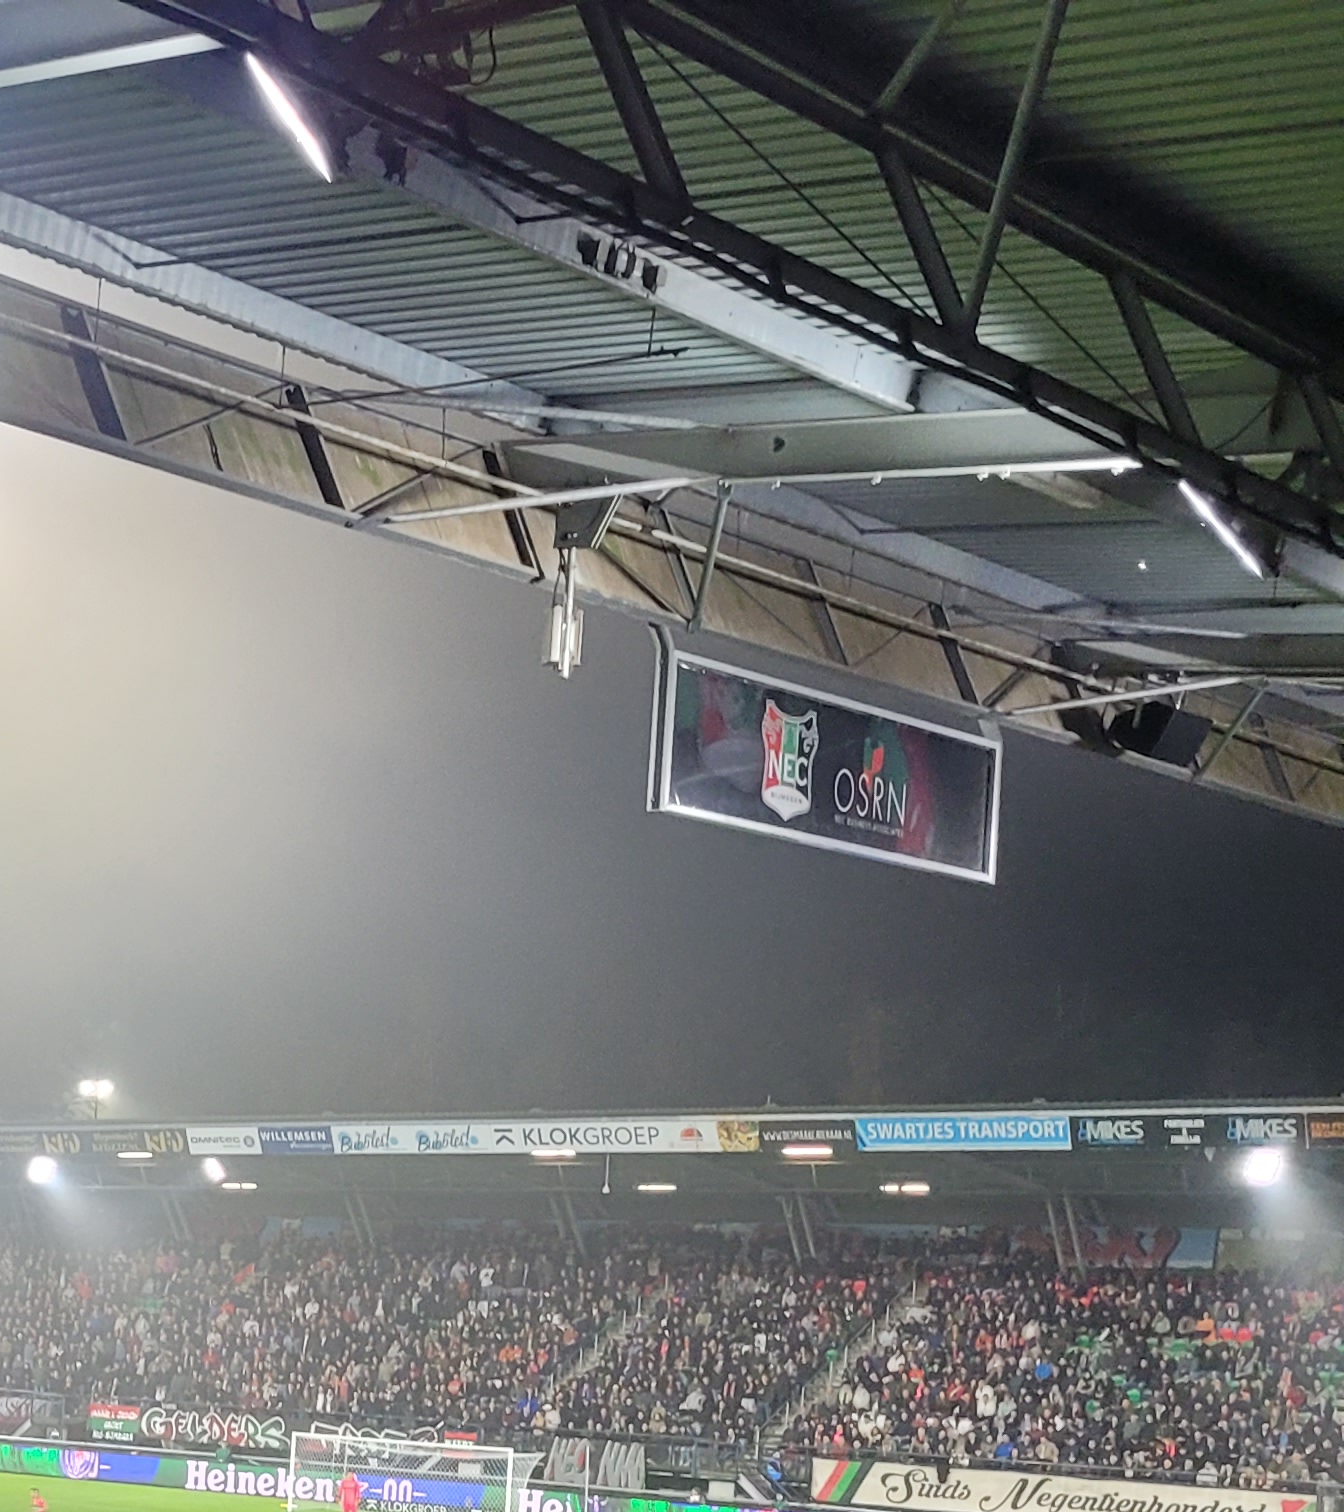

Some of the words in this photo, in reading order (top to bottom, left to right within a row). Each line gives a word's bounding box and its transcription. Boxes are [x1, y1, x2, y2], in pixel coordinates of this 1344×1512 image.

[768, 749, 809, 787] NEC
[834, 768, 906, 826] OSRN
[259, 1130, 327, 1143] WILLEMSEN
[522, 1126, 660, 1148] KLOKGROEP
[867, 1121, 954, 1140] SWARTJES
[957, 1119, 1066, 1140] TRANSPORT
[184, 1459, 335, 1503] Heineken
